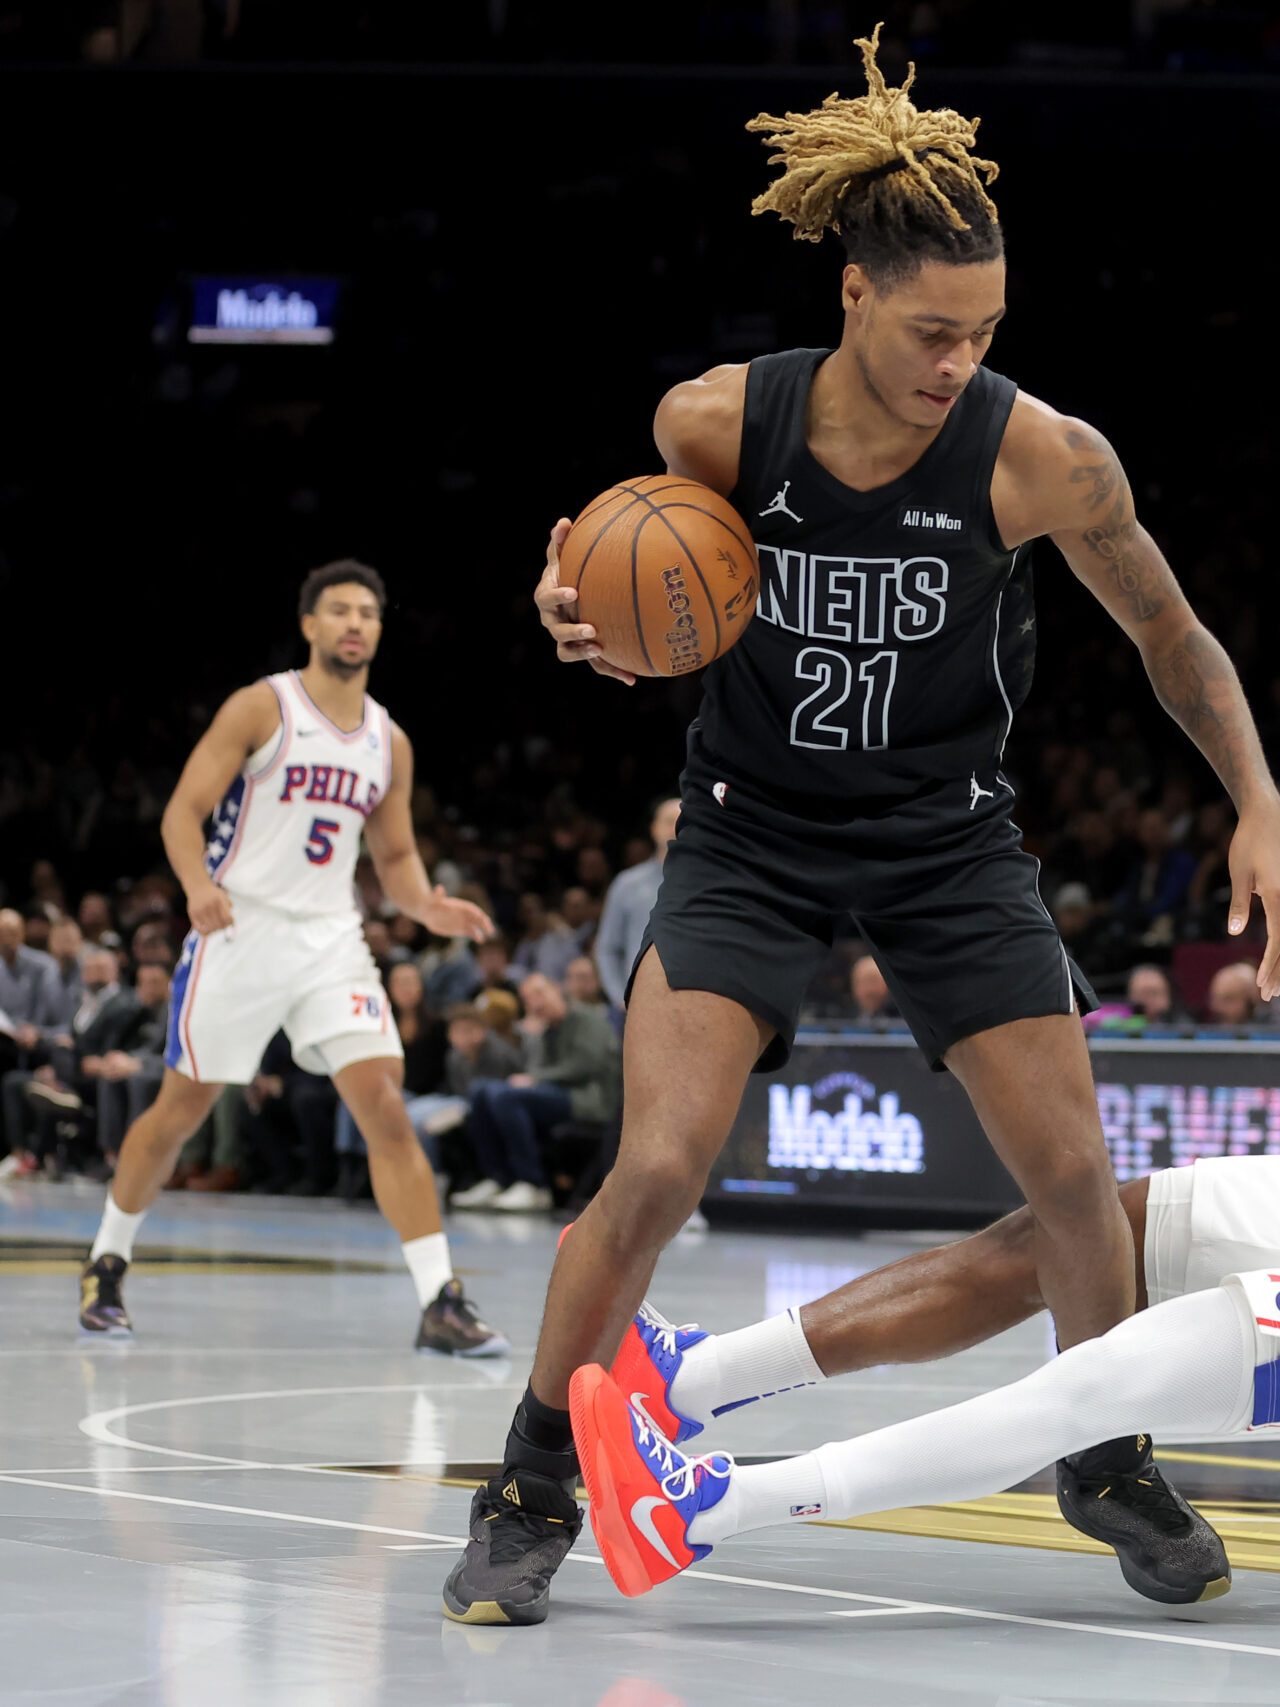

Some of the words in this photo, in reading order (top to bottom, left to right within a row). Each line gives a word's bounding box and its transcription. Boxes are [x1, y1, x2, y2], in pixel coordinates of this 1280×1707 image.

[902, 510, 920, 527] All
[922, 511, 934, 528] In
[936, 512, 962, 531] Won
[755, 543, 949, 644] NETS
[790, 646, 898, 750] 21
[304, 817, 341, 866] 5
[350, 994, 380, 1018] 76
[767, 1084, 925, 1174] Modelo
